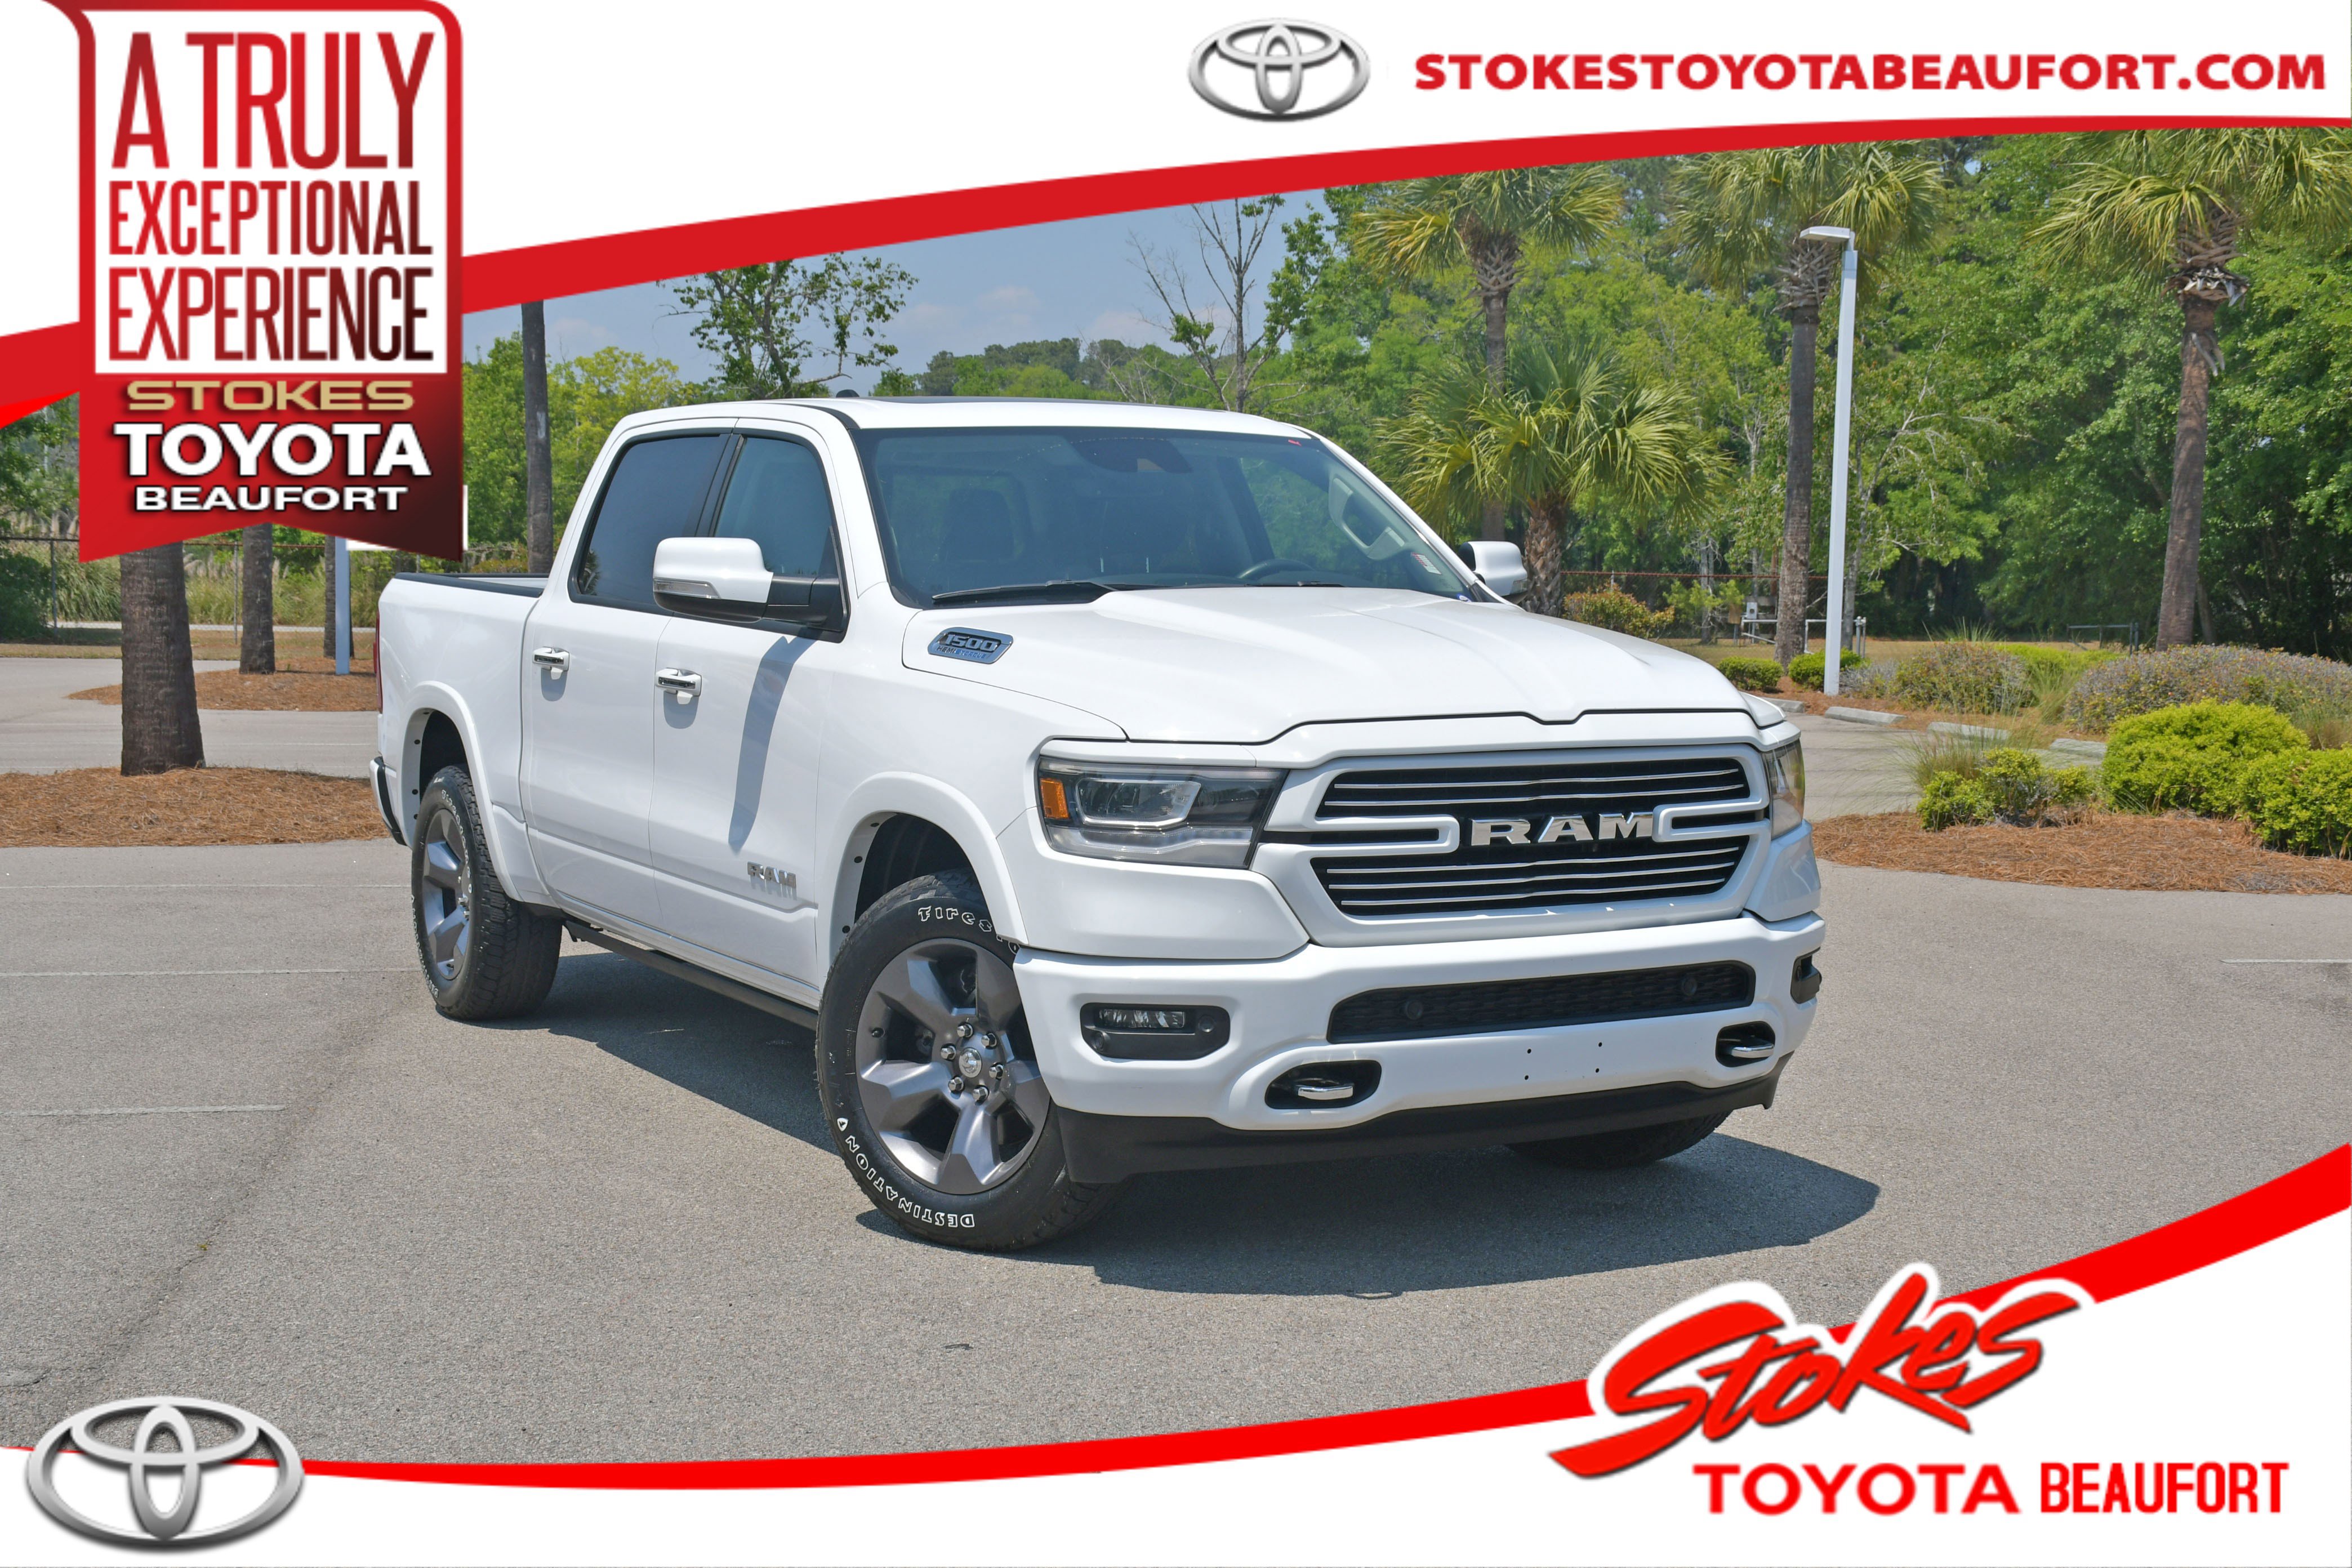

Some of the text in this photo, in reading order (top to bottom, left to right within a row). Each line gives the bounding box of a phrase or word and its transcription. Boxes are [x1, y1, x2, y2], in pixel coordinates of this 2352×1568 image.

[936, 645, 956, 654] HEMI
[945, 634, 998, 652] 1500
[1471, 812, 1654, 845] RAM
[747, 861, 797, 888] RAM
[845, 1135, 975, 1228] DESTINATION
